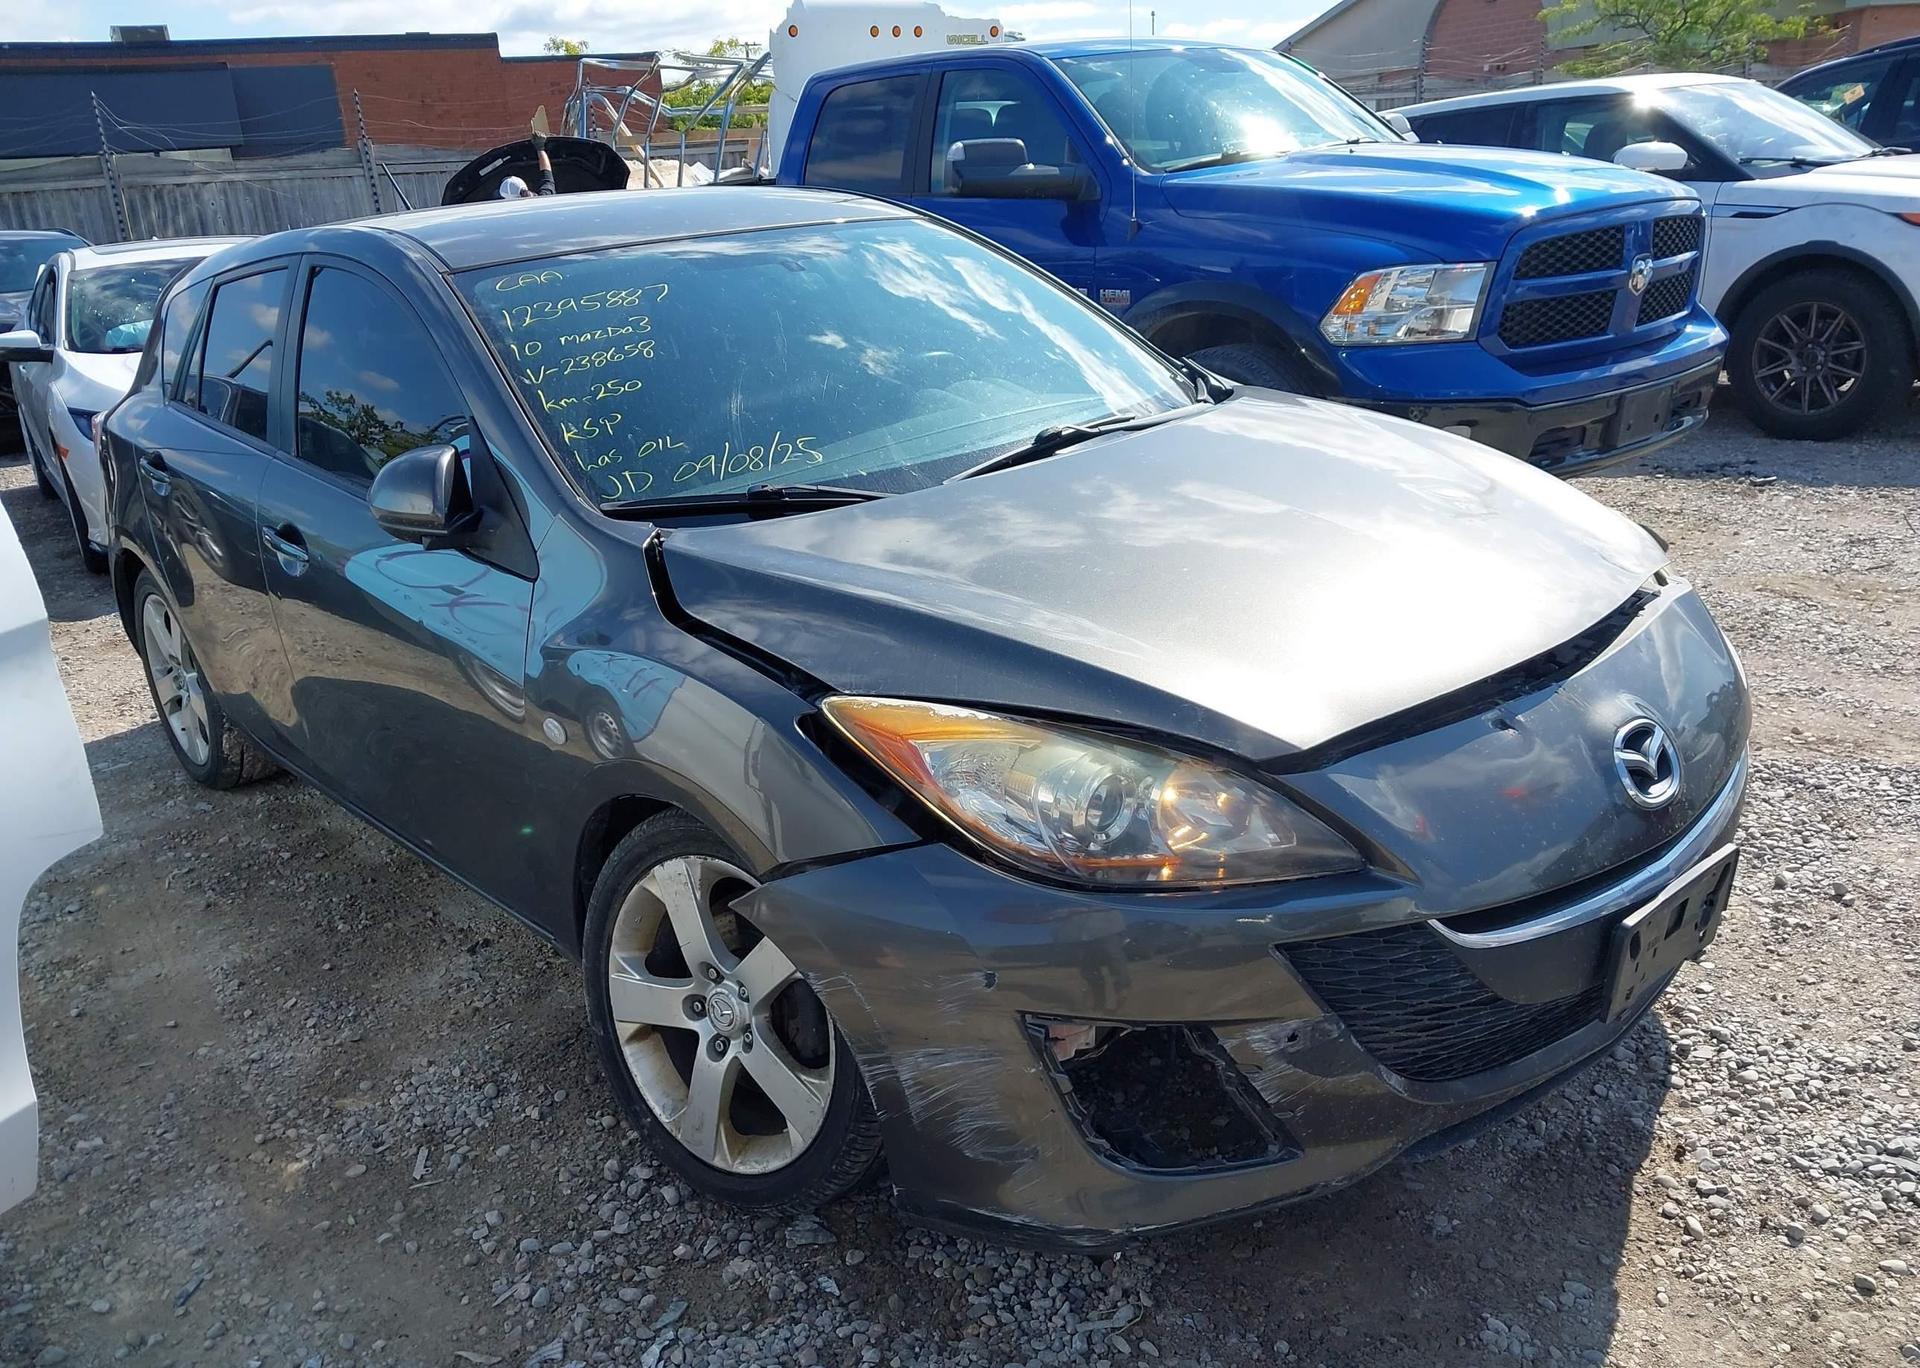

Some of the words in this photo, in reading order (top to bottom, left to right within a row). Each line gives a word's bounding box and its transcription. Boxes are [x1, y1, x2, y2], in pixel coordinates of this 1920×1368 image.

[495, 270, 563, 291] CAA
[1099, 288, 1131, 298] HEMI
[502, 283, 669, 333] 12395887
[510, 341, 542, 361] 10
[574, 448, 623, 472] has
[638, 435, 684, 457] OIL
[600, 470, 653, 499] JD
[673, 431, 823, 483] 09/08/25
